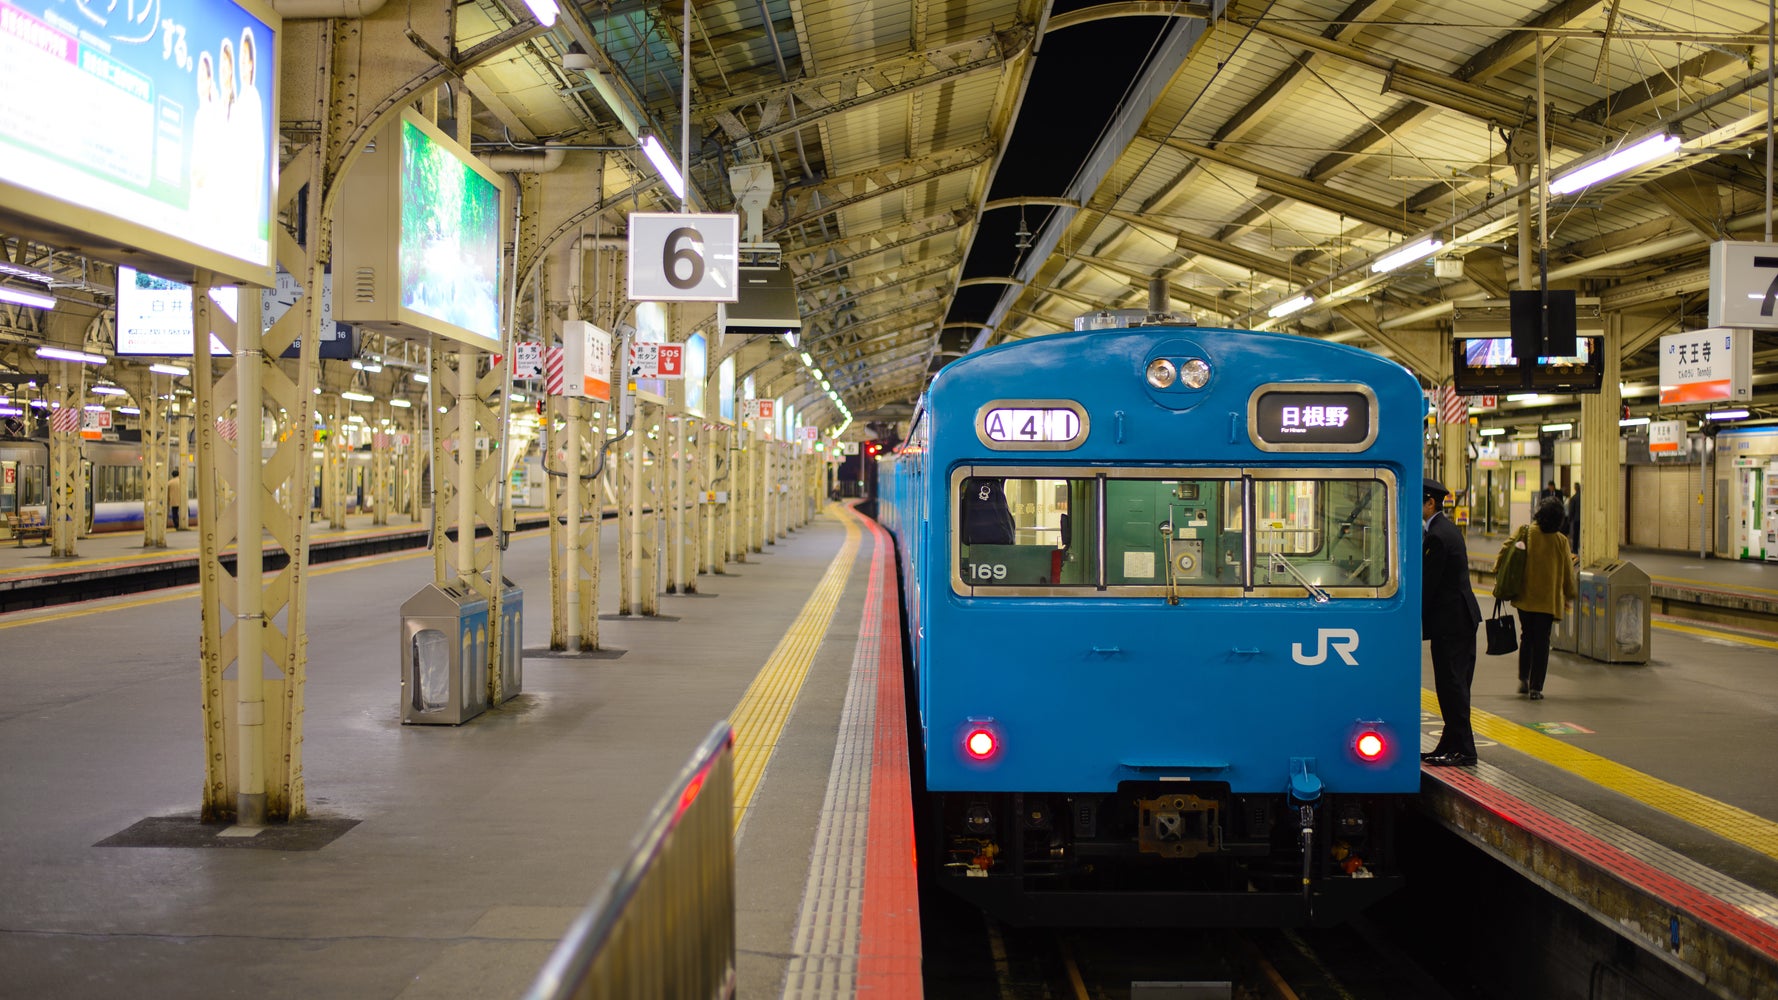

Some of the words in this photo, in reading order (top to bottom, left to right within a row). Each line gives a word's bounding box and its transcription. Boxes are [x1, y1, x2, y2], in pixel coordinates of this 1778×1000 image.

[662, 226, 705, 290] 6
[1754, 256, 1778, 317] 7
[264, 302, 270, 311] 9
[324, 304, 330, 312] 3
[336, 331, 346, 339] 16
[660, 349, 680, 358] SOS
[1678, 340, 1712, 366] 天王寺
[1282, 406, 1349, 427] 日根野
[969, 563, 1007, 580] 169
[1291, 628, 1360, 666] JR
